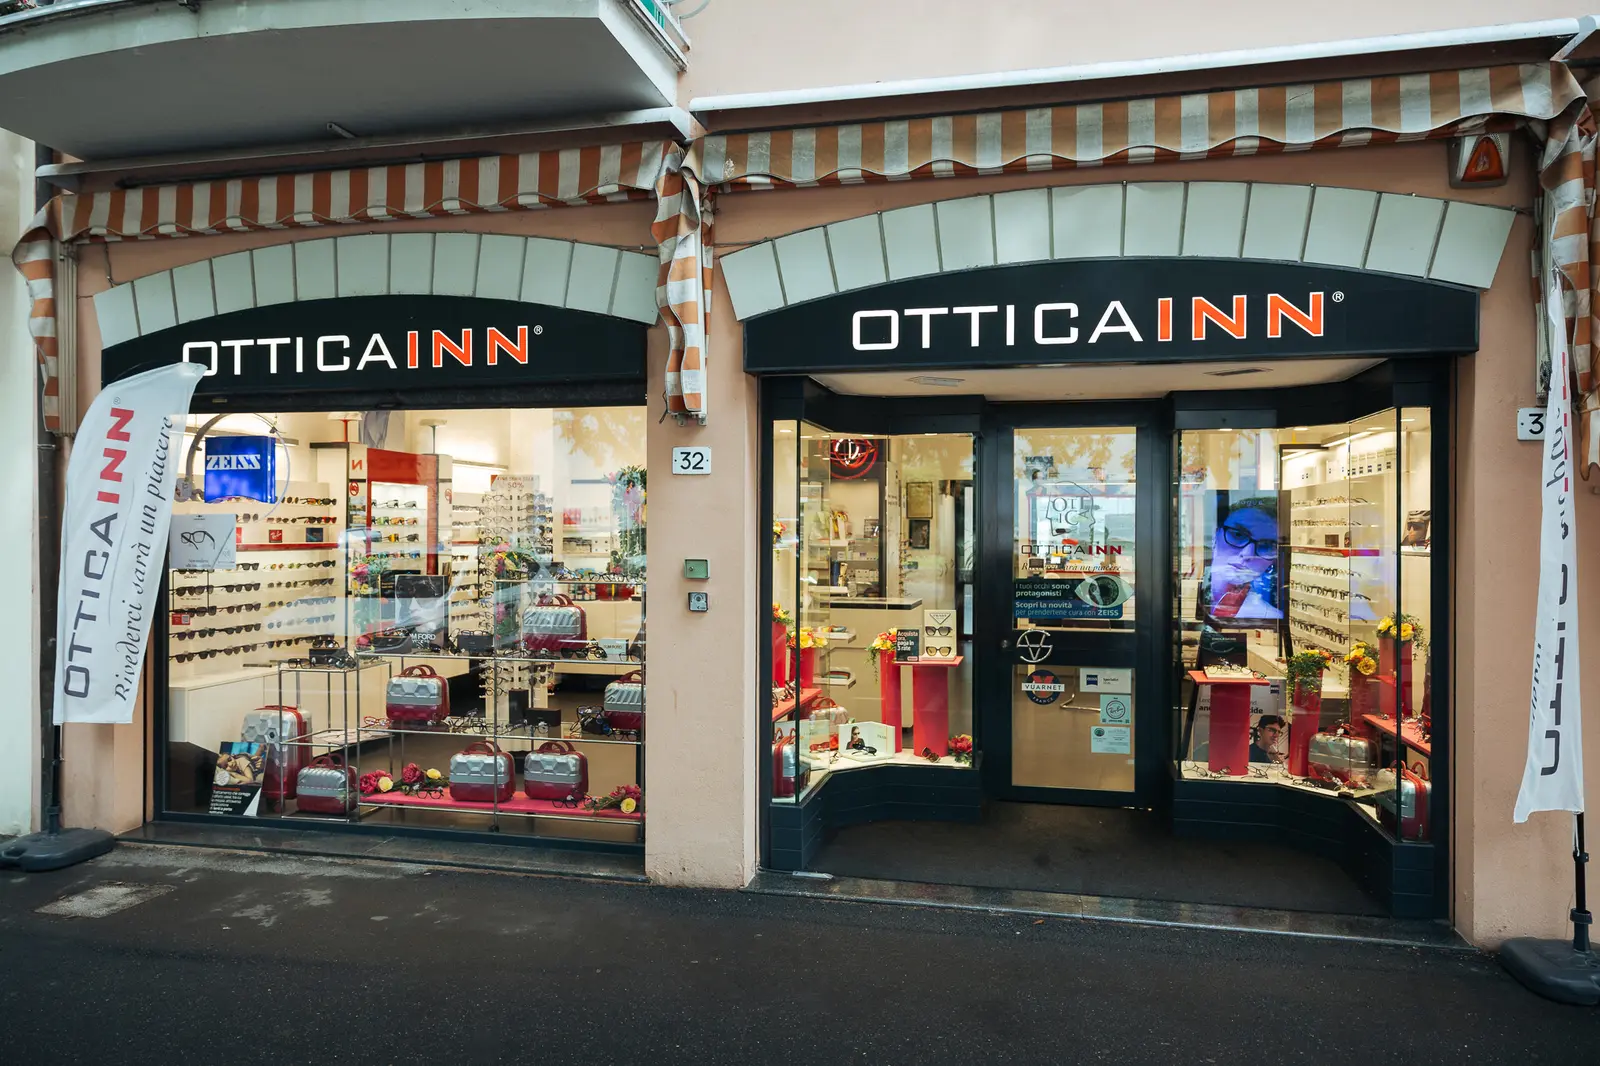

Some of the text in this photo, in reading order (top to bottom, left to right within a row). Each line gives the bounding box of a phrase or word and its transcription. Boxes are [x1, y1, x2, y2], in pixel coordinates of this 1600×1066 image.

[206, 454, 261, 470] ZEISS
[680, 452, 704, 470] 32
[113, 416, 173, 701] Rivederci sarà un piacere
[1015, 590, 1062, 598] protagonisti
[1015, 601, 1039, 610] Scopri
[1048, 600, 1073, 609] novità
[1015, 610, 1026, 618] per
[1027, 609, 1067, 618] prendertene
[417, 633, 436, 641] FORD
